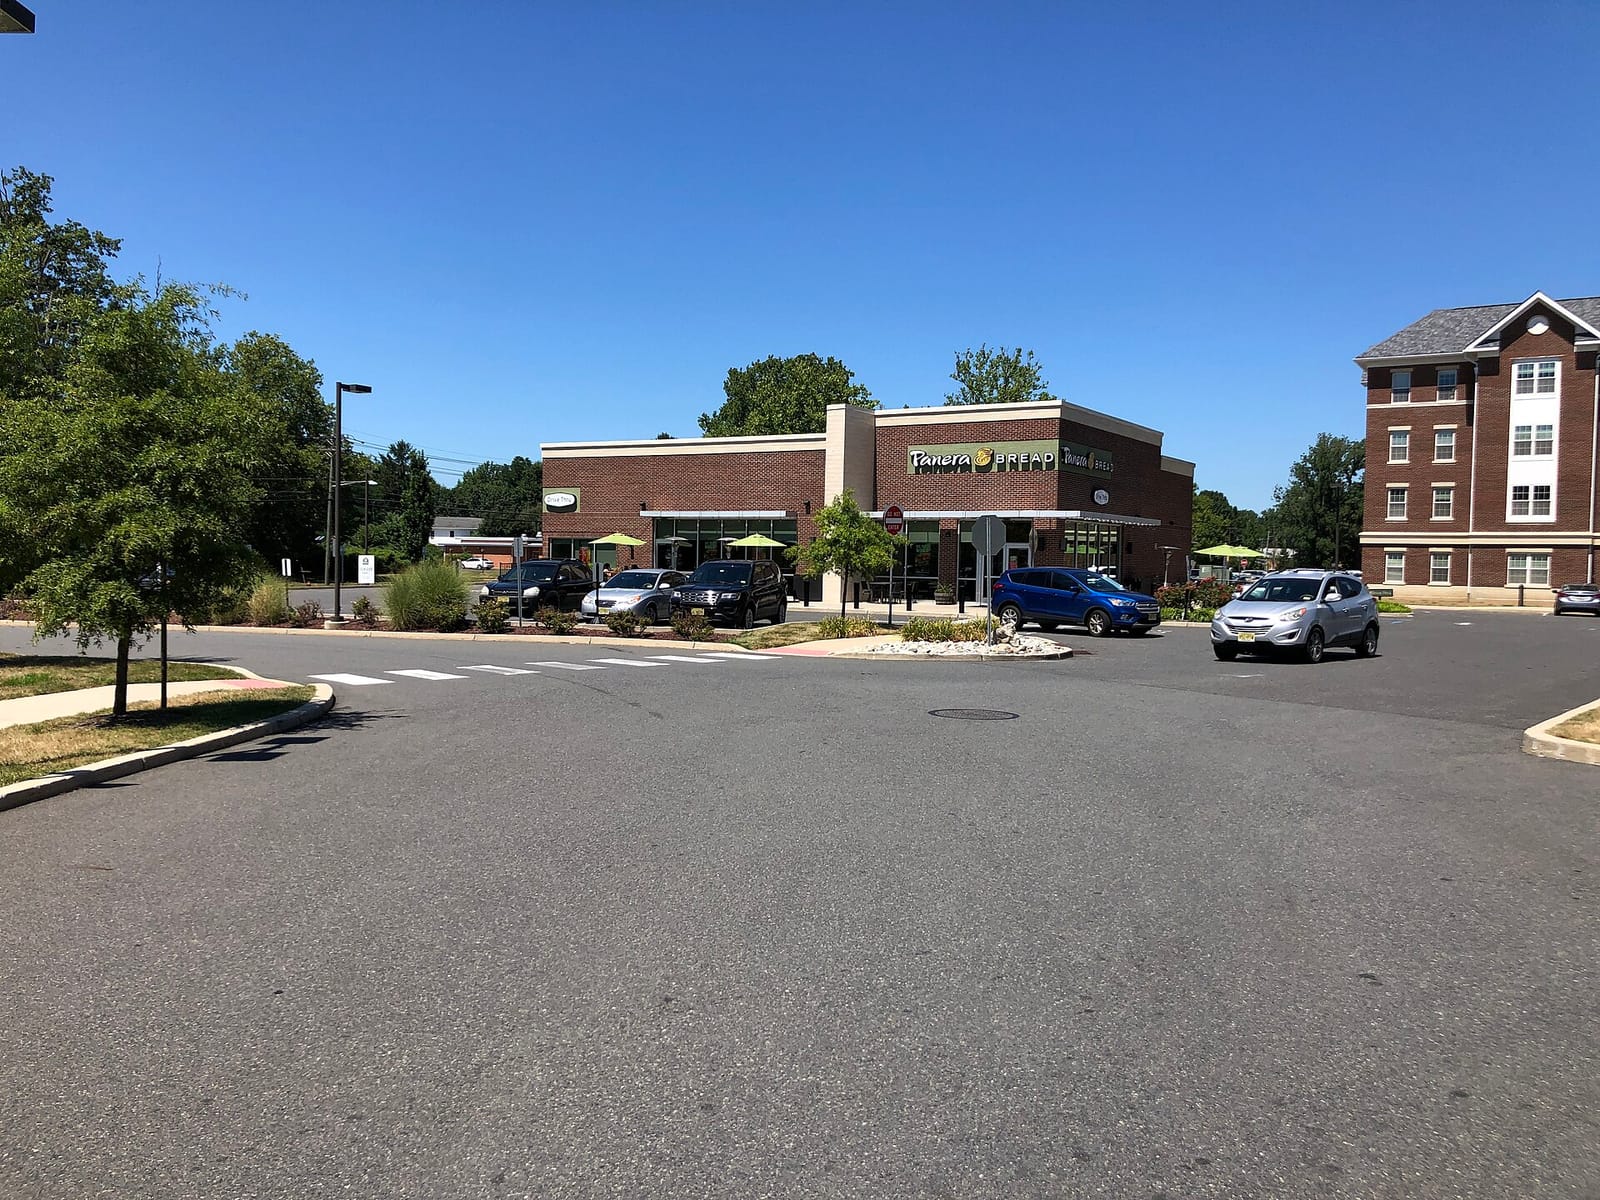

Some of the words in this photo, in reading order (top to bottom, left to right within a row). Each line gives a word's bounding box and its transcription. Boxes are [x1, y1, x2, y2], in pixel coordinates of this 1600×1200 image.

[909, 450, 971, 467] Panera
[995, 452, 1055, 464] BREAD
[1060, 446, 1088, 468] Panera
[1095, 459, 1114, 472] BREAD
